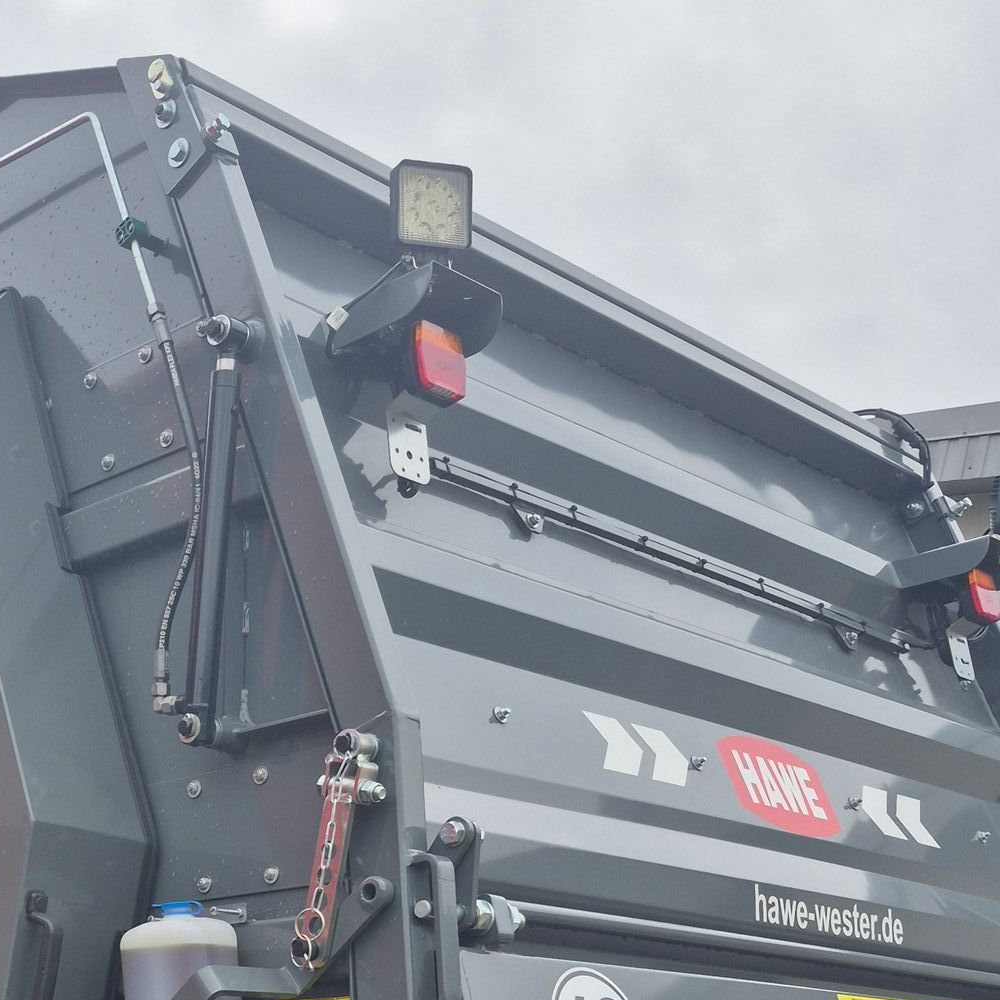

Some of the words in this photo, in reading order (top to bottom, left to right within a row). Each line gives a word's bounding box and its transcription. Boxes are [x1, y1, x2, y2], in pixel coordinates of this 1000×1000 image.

[176, 568, 184, 581] WP
[185, 537, 195, 554] BAR
[190, 514, 200, 537] MSHA
[731, 749, 829, 820] HAWE
[754, 883, 904, 944] hawe-wester.de
